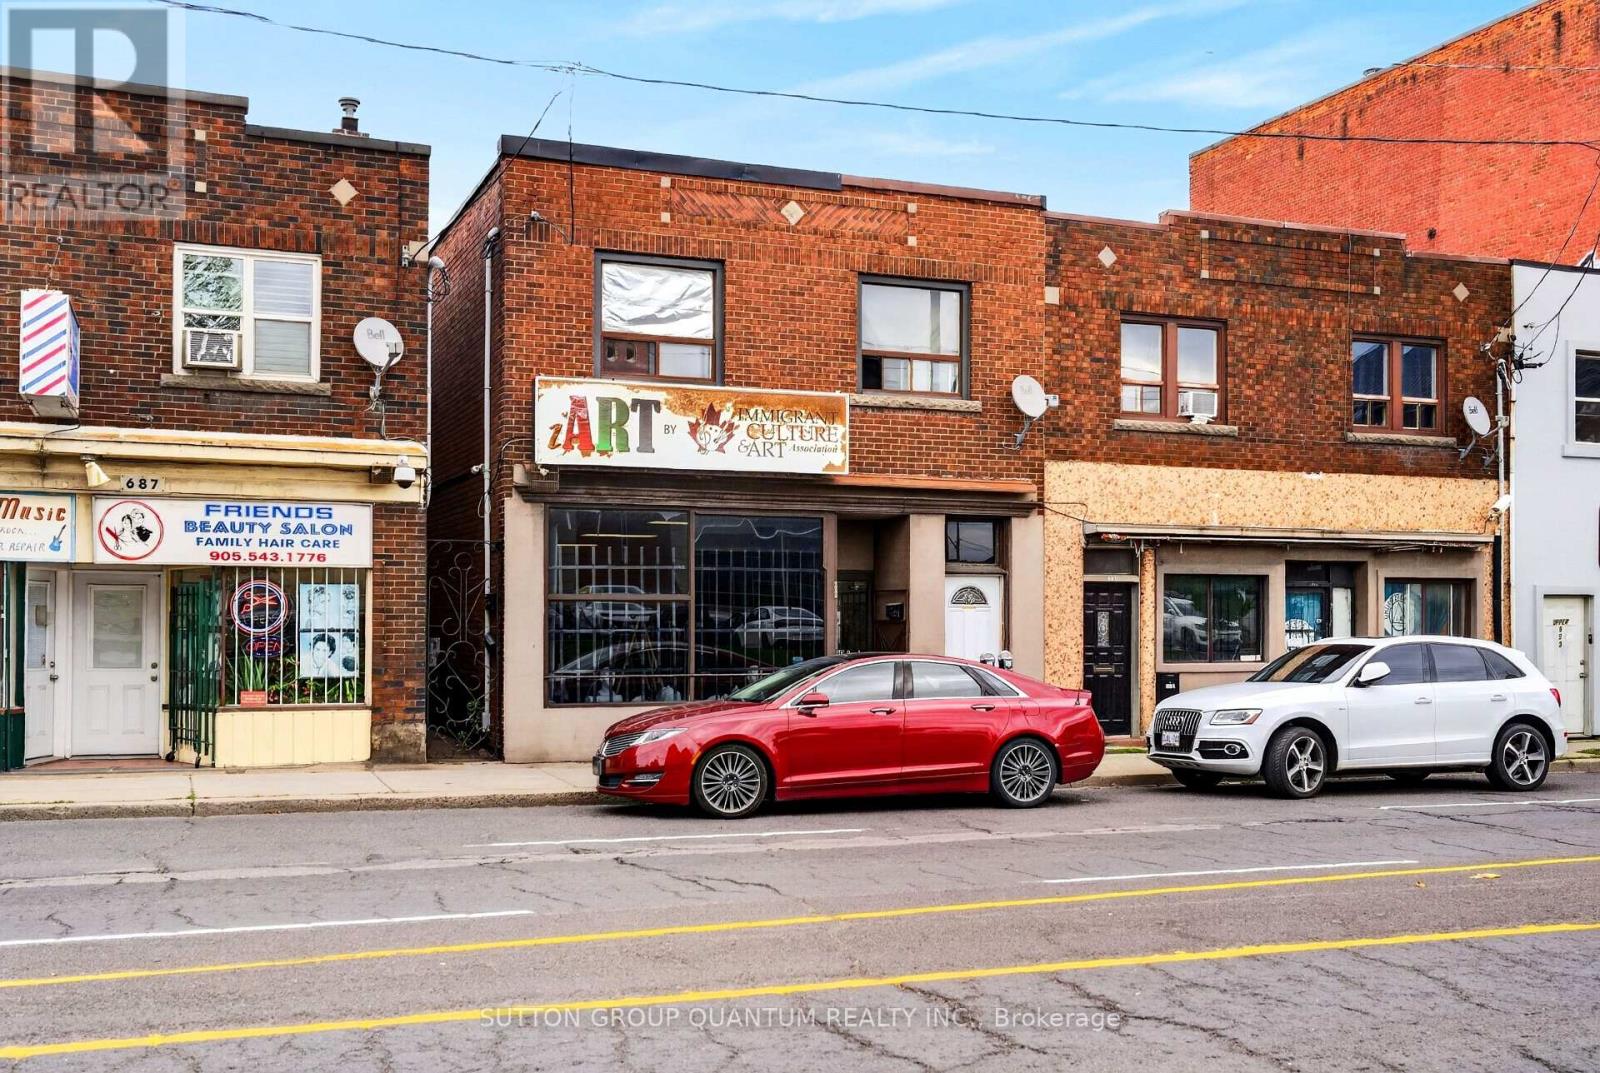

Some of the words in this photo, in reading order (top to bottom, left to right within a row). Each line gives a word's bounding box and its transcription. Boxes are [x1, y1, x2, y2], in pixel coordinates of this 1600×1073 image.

[737, 407, 839, 426] IMMIGRANT
[664, 424, 676, 435] BY
[746, 423, 839, 443] CULTURE
[789, 443, 838, 454] Association
[126, 478, 159, 490] 687
[205, 504, 333, 520] FRIENDS
[184, 520, 272, 535] BEAUTY
[280, 522, 354, 537] SALON
[196, 537, 253, 548] FAMILY
[258, 538, 295, 549] HAIR
[300, 539, 341, 550] CARE
[209, 551, 328, 563] 905.543.1776
